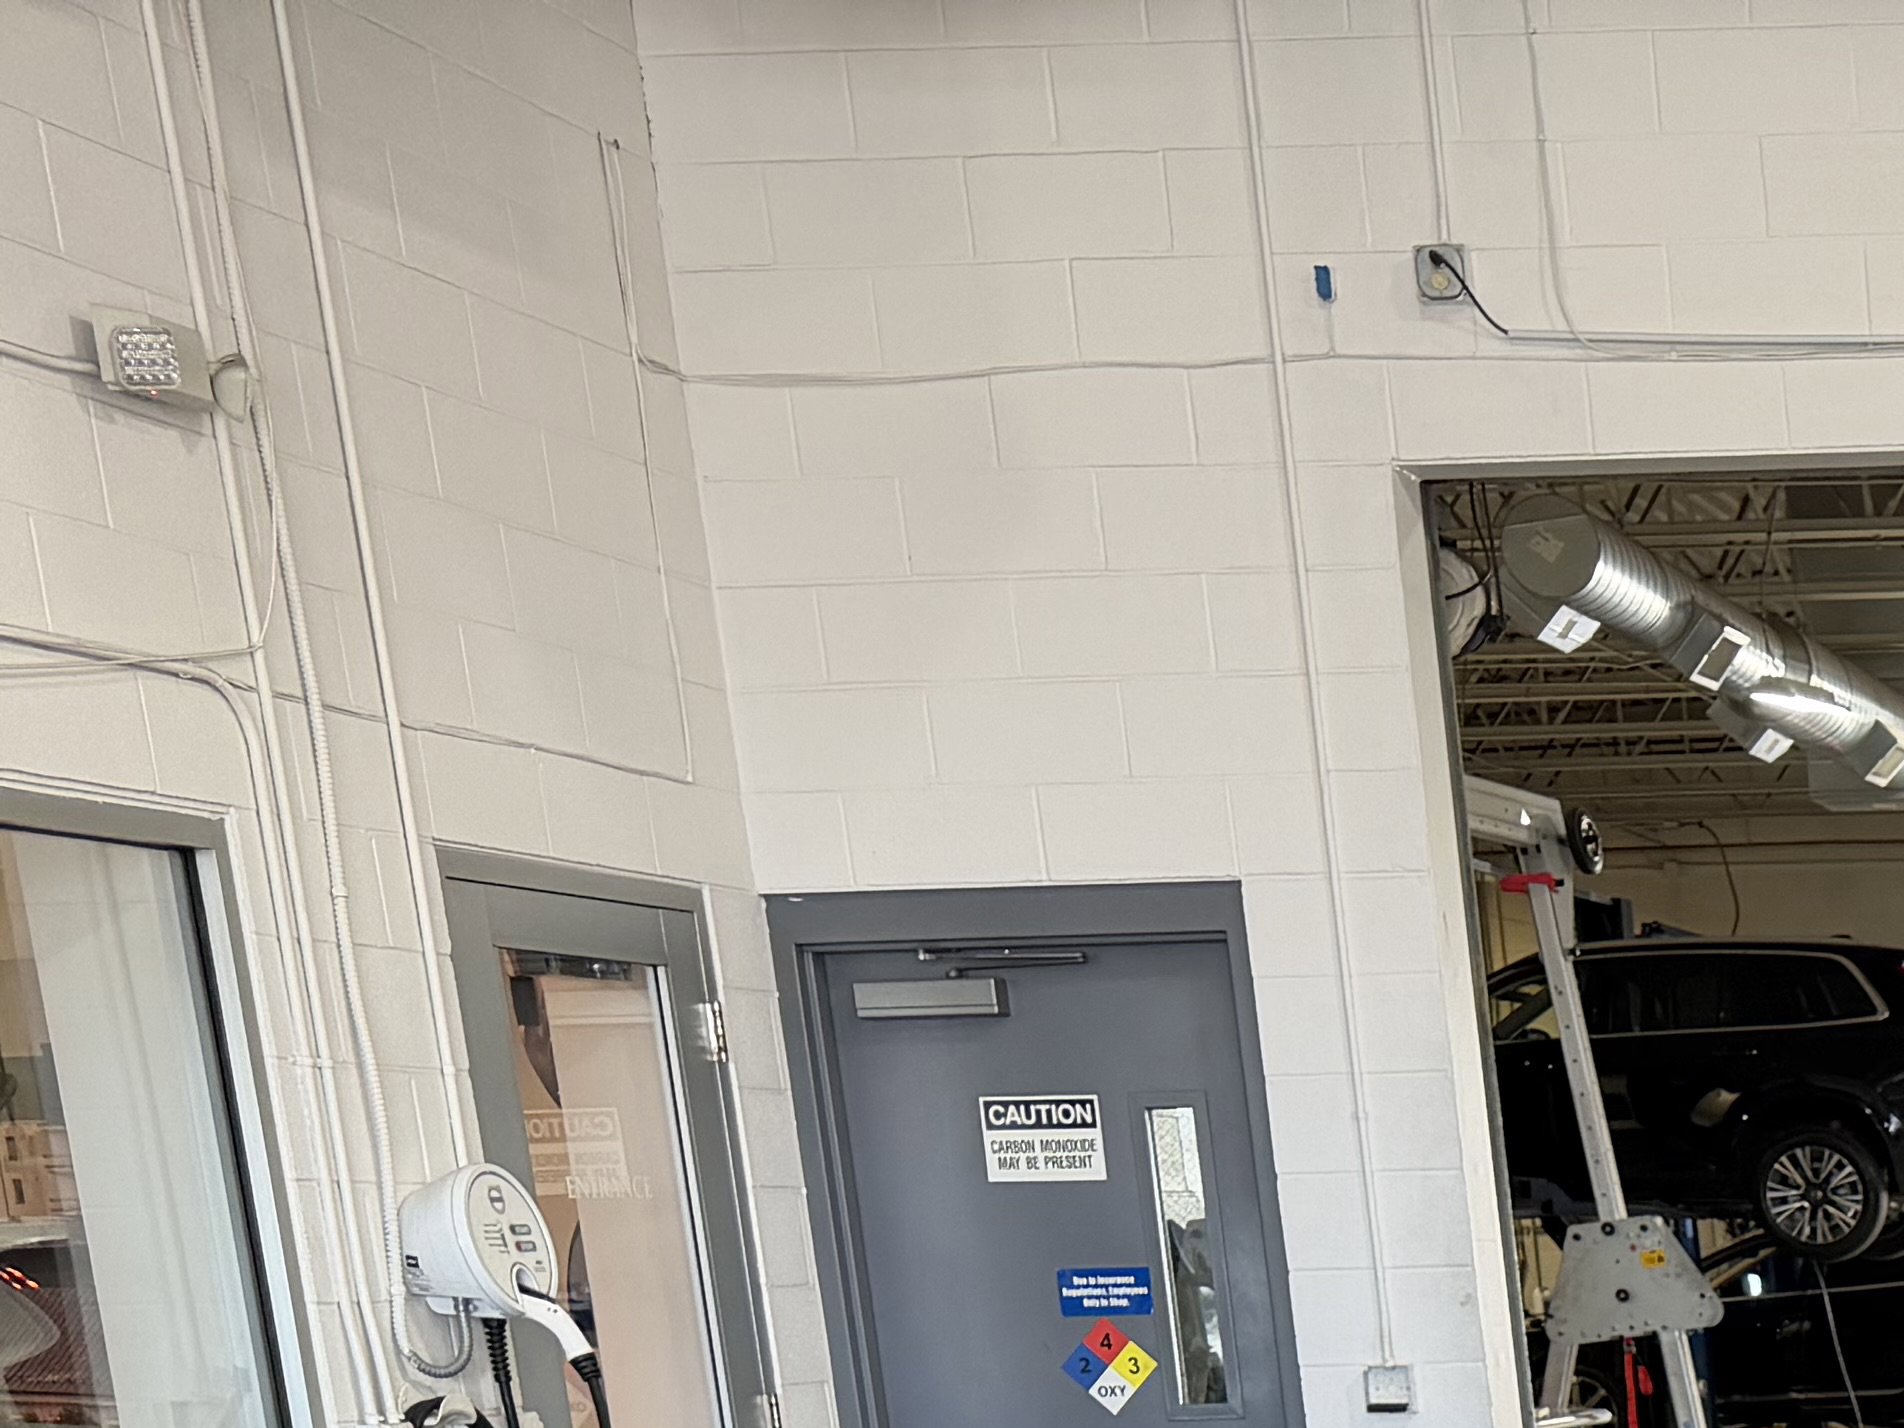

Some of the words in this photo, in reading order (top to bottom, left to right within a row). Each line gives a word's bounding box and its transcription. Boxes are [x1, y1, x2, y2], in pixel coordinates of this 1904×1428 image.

[988, 1103, 1093, 1125] CAUTION
[990, 1139, 1036, 1154] CARBON
[1040, 1138, 1098, 1153] MONOXIDE
[998, 1156, 1020, 1170] MAY
[1026, 1155, 1040, 1170] BE
[1044, 1154, 1093, 1169] PRESENT
[565, 1175, 654, 1200] ENTRANCE
[1100, 1332, 1113, 1350] 4
[1079, 1357, 1092, 1374] 2
[1128, 1357, 1140, 1375] 3
[1097, 1385, 1126, 1398] OXY
